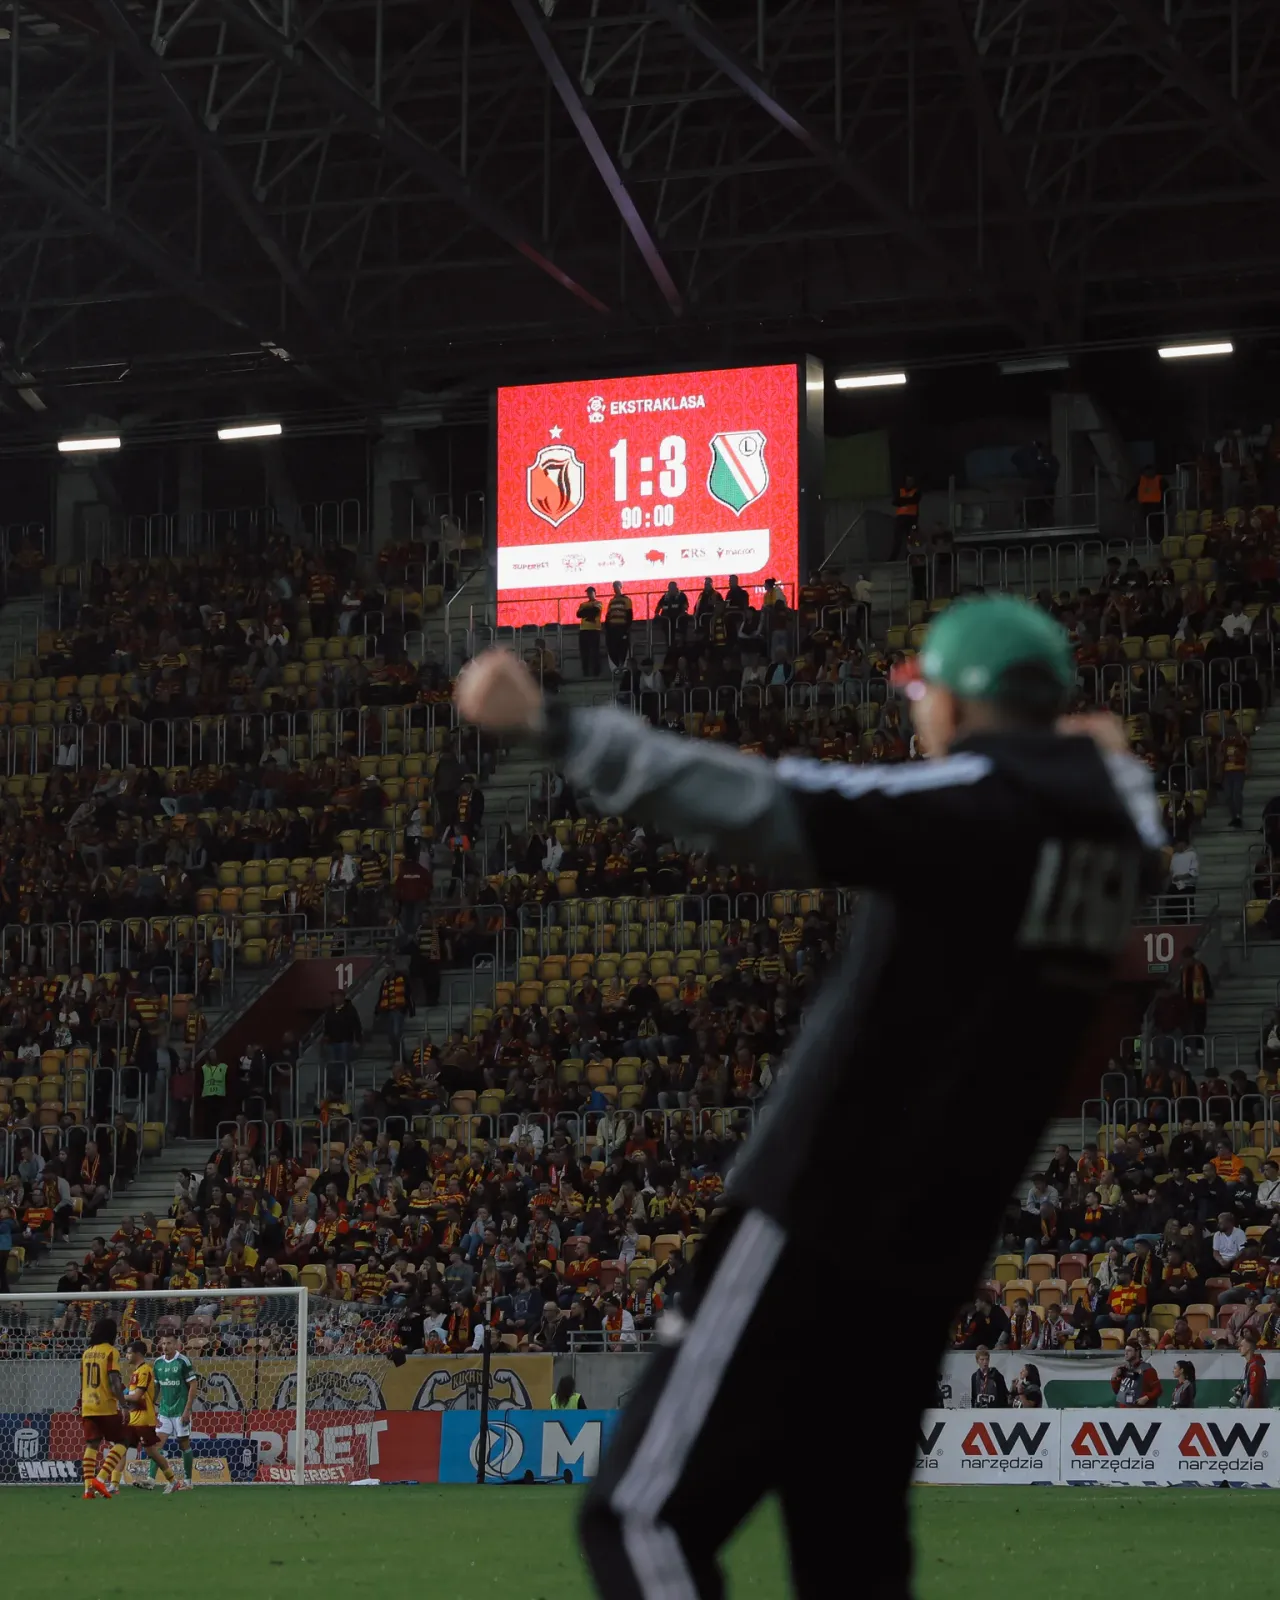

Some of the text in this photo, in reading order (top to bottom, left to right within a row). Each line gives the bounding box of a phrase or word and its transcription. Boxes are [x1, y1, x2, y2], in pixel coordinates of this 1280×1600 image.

[610, 395, 706, 415] EKSTRAKLASA
[621, 503, 675, 529] 90:00
[1143, 932, 1175, 963] 10
[335, 962, 353, 990] 11
[85, 1362, 101, 1389] 10
[452, 1369, 493, 1390] KUCHN
[961, 1422, 1051, 1456] AW
[1071, 1422, 1162, 1456] AW
[1178, 1422, 1271, 1457] AW
[961, 1457, 1043, 1473] narzędzia
[1071, 1457, 1155, 1473] narzędzia
[1178, 1458, 1264, 1474] narzędzia
